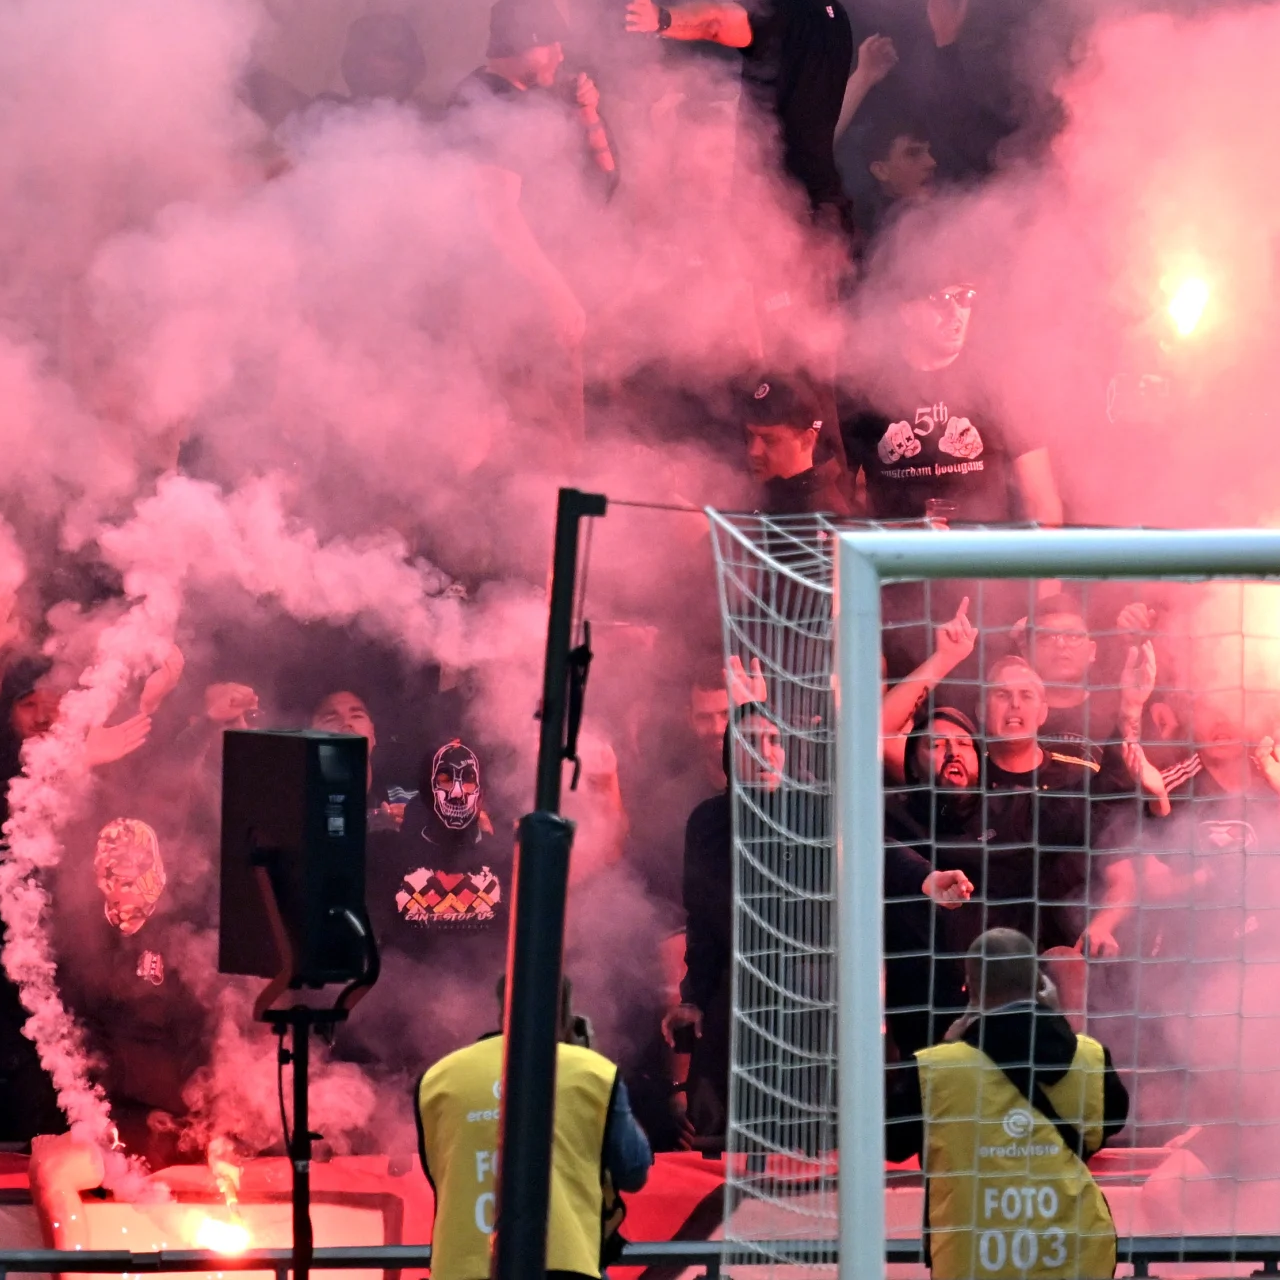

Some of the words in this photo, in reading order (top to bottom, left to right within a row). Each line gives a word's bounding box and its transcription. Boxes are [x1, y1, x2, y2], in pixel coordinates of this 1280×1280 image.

[913, 401, 949, 437] 5th
[441, 912, 476, 922] STOP
[476, 910, 497, 921] US
[979, 1143, 1061, 1158] eredivisie
[983, 1185, 1059, 1220] FOTO
[979, 1226, 1069, 1272] 003
